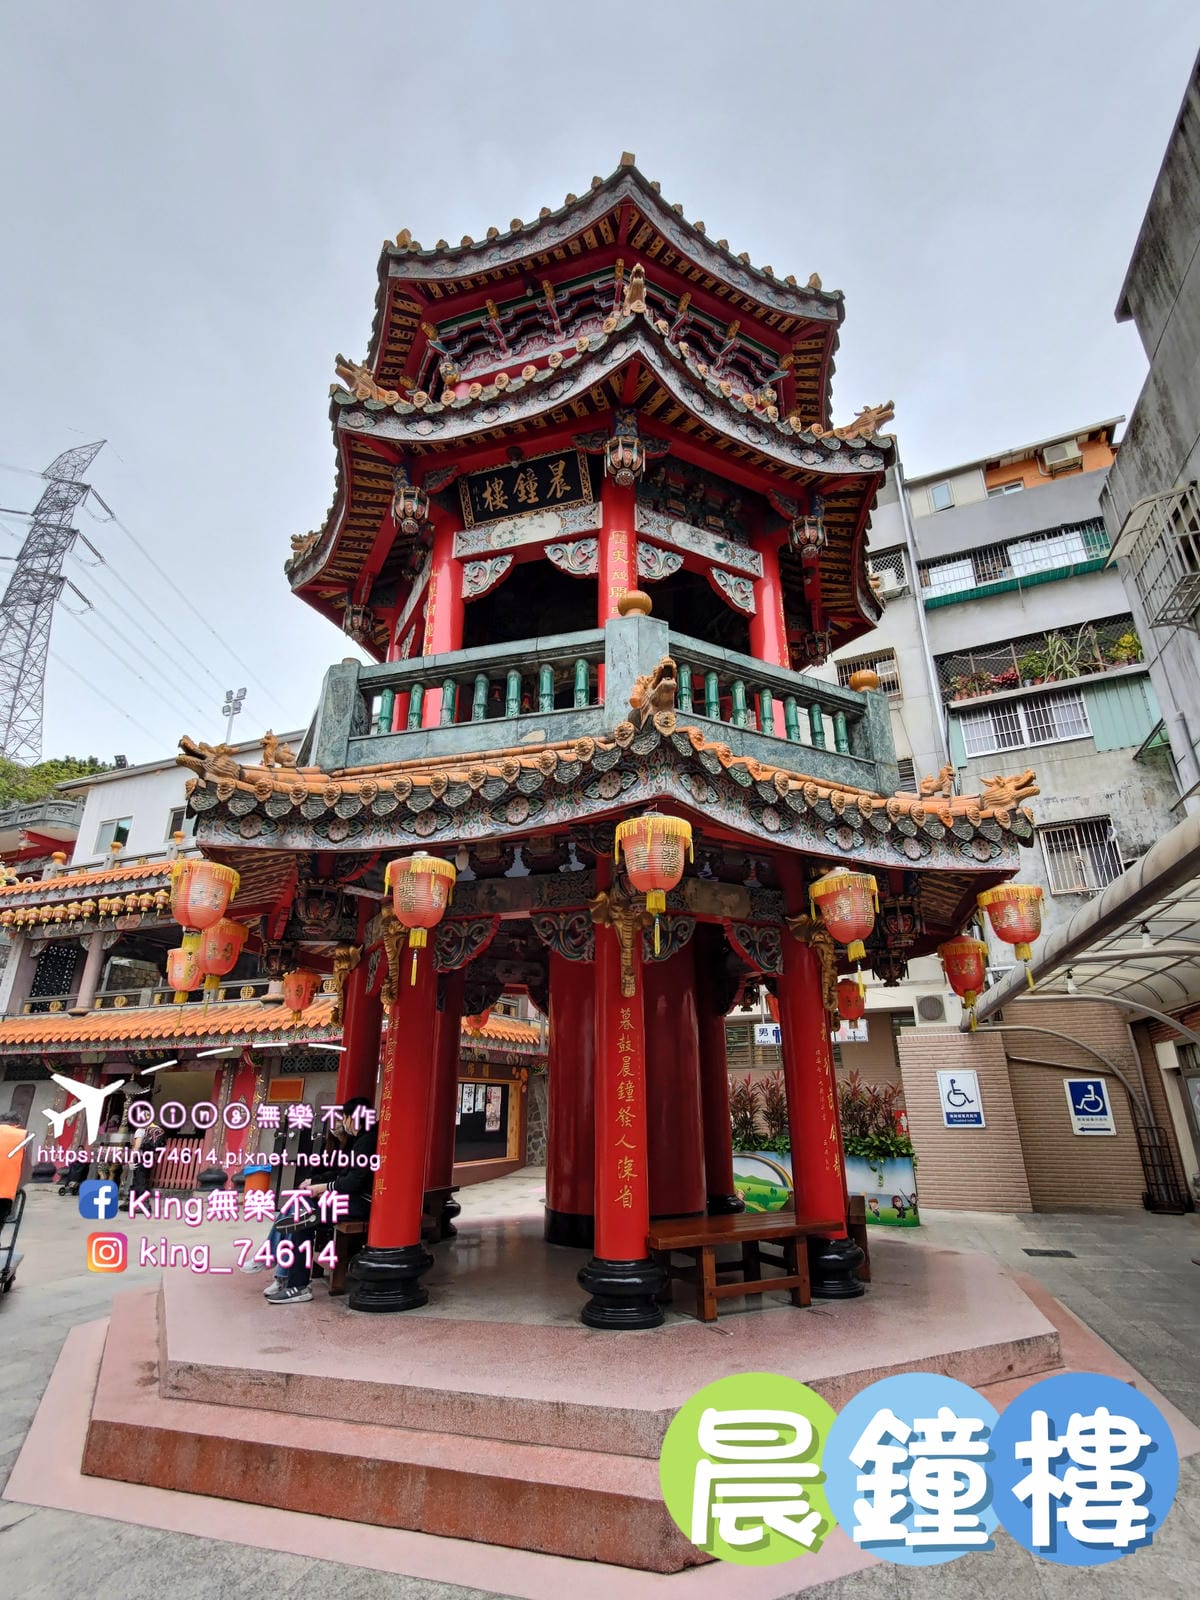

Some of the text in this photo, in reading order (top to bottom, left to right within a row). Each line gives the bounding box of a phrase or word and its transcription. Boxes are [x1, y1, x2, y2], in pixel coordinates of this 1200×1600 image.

[481, 459, 572, 512] 晨鐘樓
[759, 1027, 768, 1036] 男
